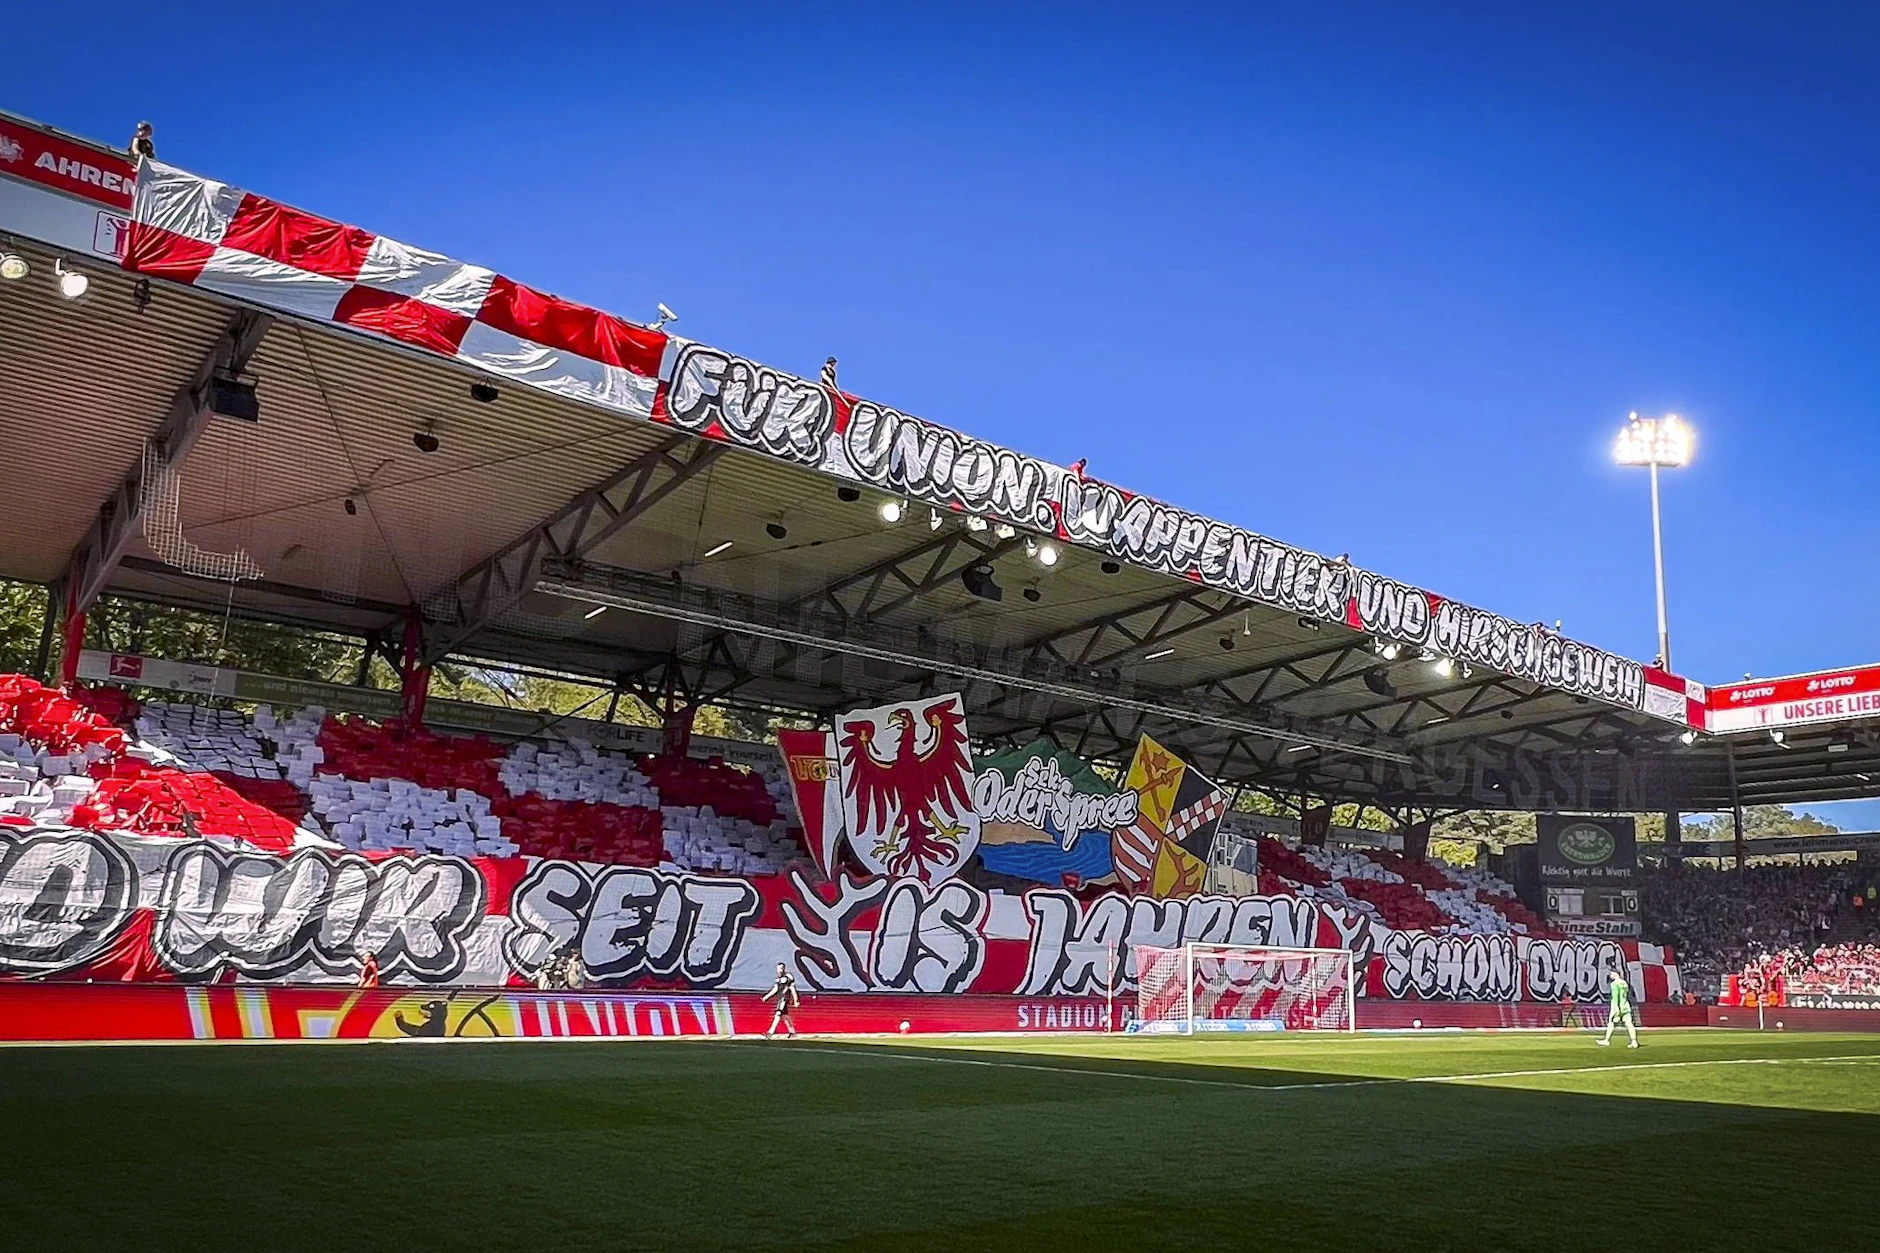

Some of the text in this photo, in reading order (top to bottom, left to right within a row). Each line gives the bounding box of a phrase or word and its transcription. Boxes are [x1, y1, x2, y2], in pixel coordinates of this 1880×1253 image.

[667, 343, 832, 463] FÜR
[1062, 473, 1348, 622] WAPPENTIER
[1356, 569, 1430, 643] UND
[1434, 599, 1645, 711] HIRSCHGEWEIH
[1742, 686, 1775, 699] LOTTO
[1820, 675, 1856, 689] LOTTO
[1784, 699, 1844, 719] UNSERE
[972, 768, 1139, 852] Oder Spree
[503, 859, 762, 982] SEIT
[1383, 930, 1518, 1000] SCHON
[1018, 1004, 1107, 1027] STADION
